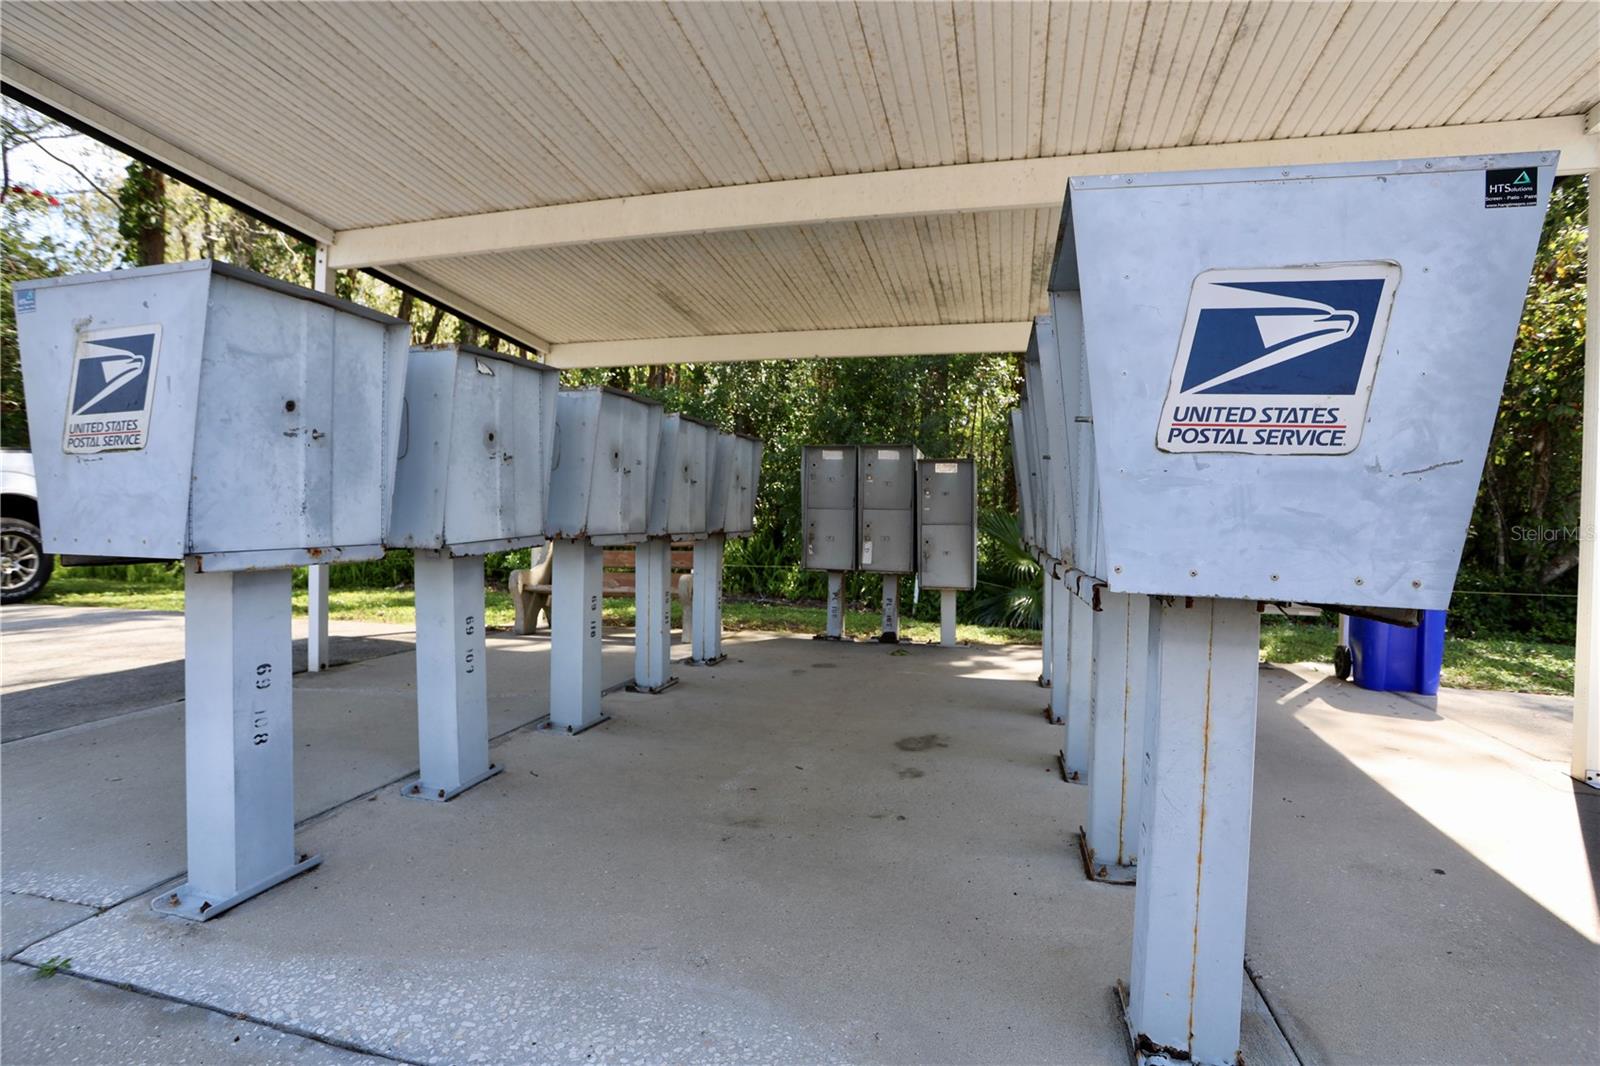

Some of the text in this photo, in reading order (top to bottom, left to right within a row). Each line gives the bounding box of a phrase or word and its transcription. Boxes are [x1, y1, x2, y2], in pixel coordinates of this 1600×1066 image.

[1173, 406, 1340, 424] UNITED STATES
[70, 420, 138, 434] UNITED STATES
[67, 434, 141, 448] POSTAL SERVICE
[1167, 428, 1248, 445] POSTAL
[465, 616, 474, 635] 69
[253, 662, 272, 746] 69 108
